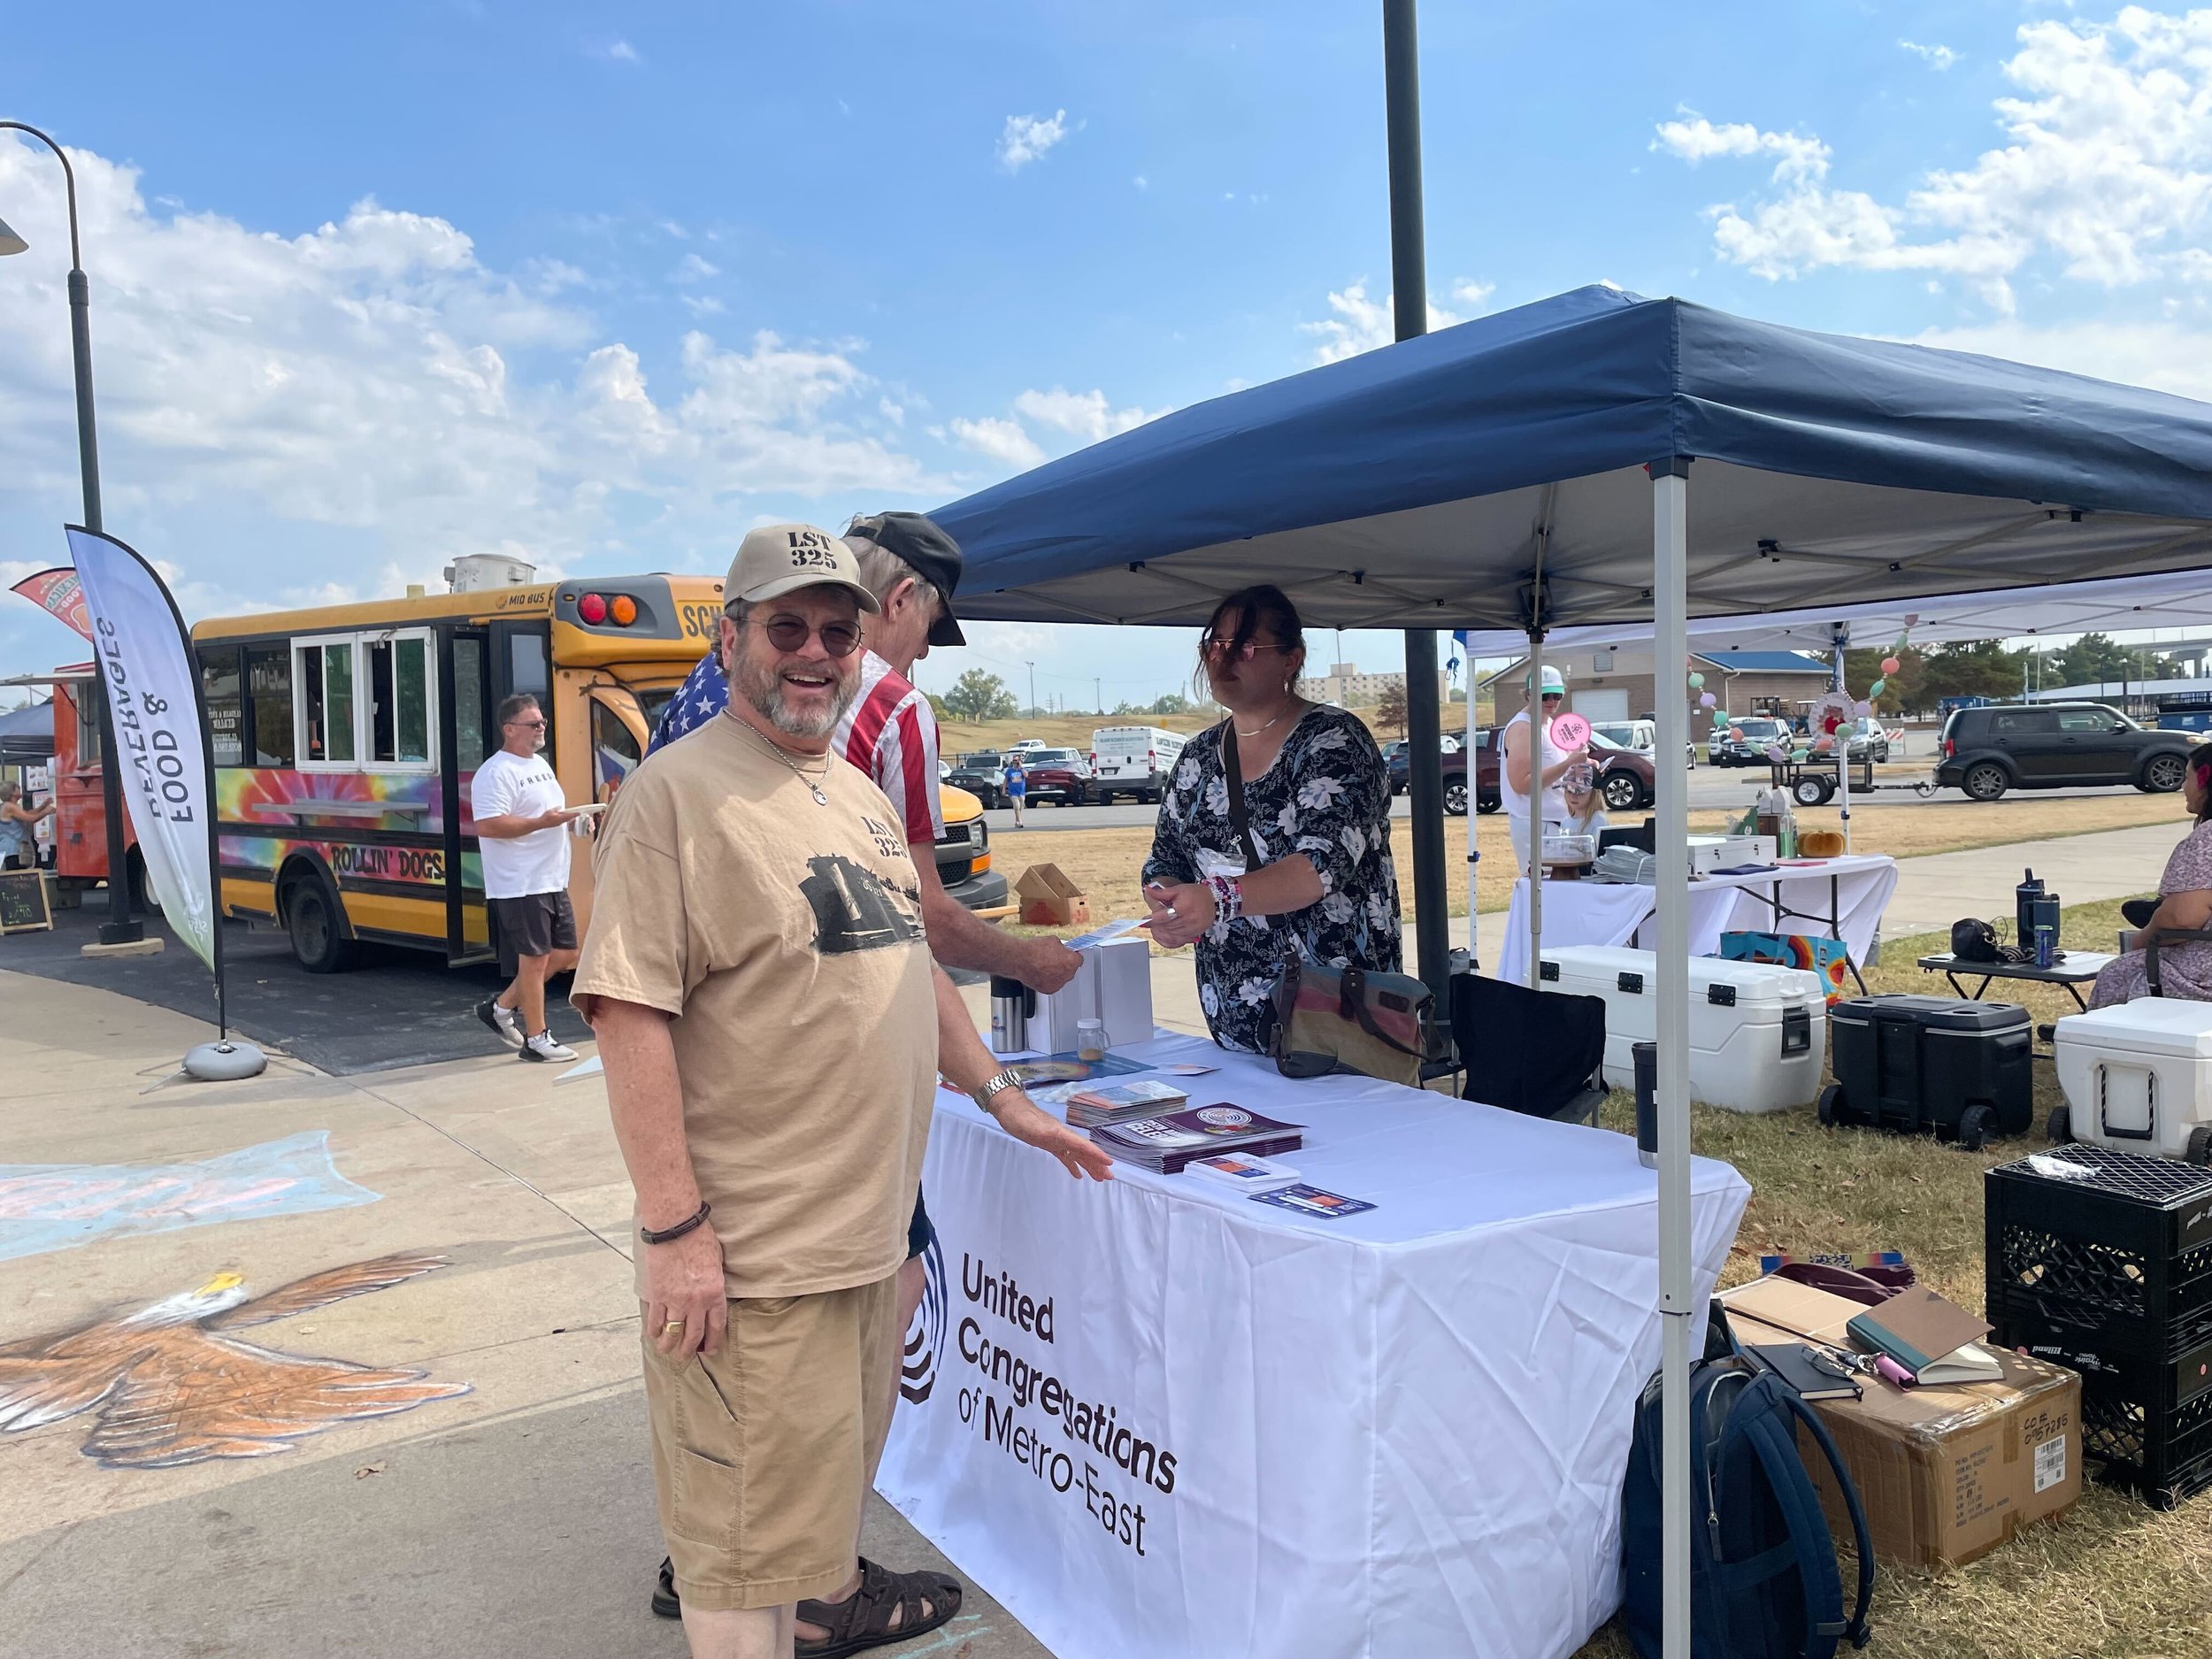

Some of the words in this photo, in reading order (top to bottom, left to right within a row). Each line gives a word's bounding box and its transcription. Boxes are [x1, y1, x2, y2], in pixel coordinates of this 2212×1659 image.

[787, 531, 831, 551] LST
[791, 549, 837, 570] 325
[509, 594, 526, 606] MID
[527, 592, 546, 604] BUS
[331, 846, 393, 873] ROLLIN'
[962, 1252, 1054, 1344] United
[958, 1317, 1178, 1494] Congregations
[958, 1386, 982, 1431] of
[984, 1395, 1146, 1557] Metro-East
